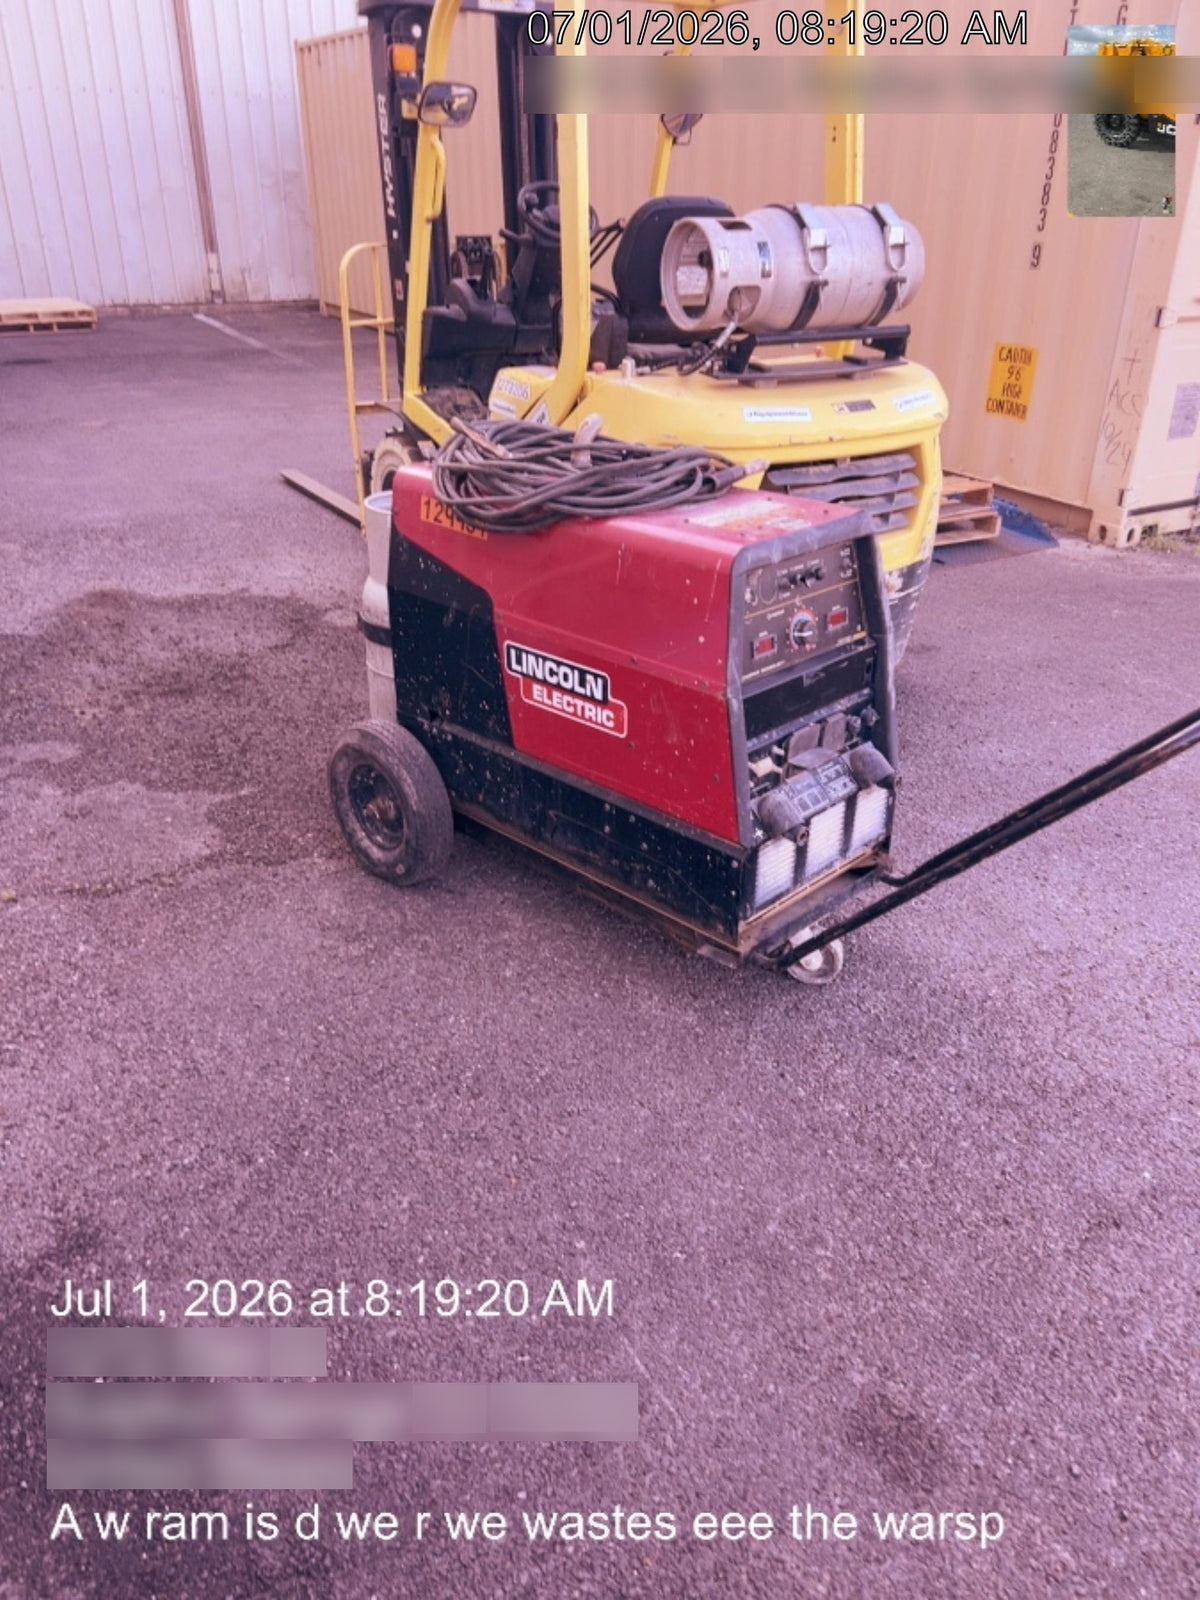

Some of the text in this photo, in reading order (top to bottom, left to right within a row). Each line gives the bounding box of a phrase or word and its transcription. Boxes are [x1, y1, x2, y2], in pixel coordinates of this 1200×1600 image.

[377, 93, 396, 217] HYSTER
[509, 647, 604, 702] LINCOLN
[532, 682, 615, 729] ELECTRIC
